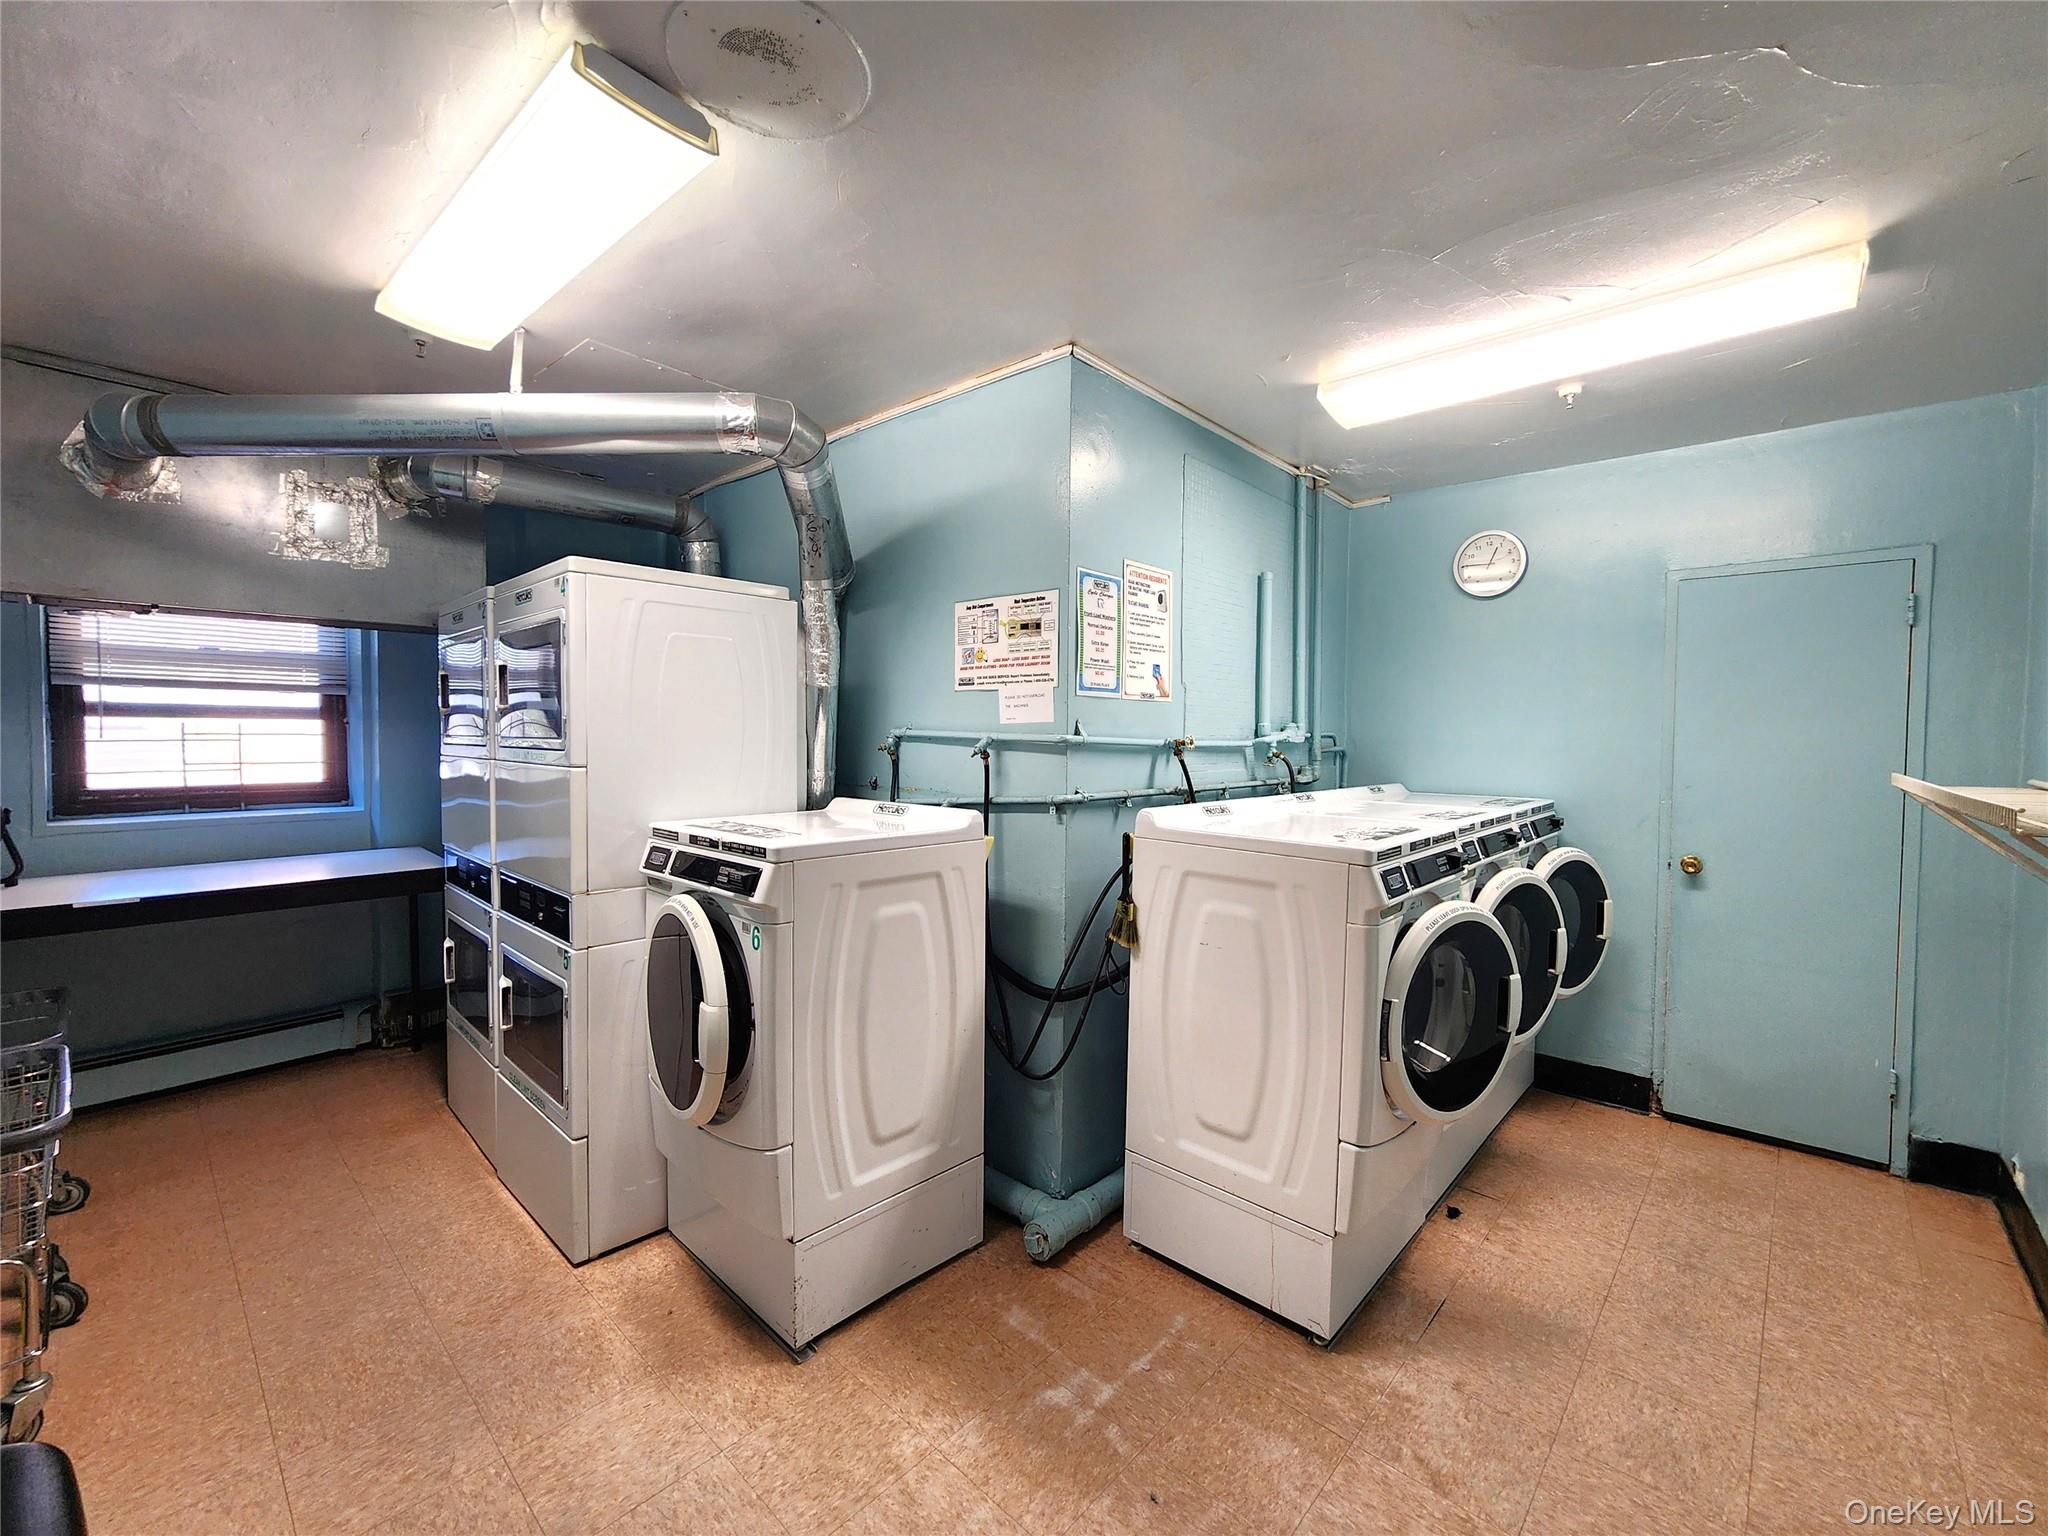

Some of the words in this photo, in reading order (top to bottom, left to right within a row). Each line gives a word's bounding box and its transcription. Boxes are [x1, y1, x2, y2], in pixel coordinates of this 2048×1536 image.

[1425, 917, 1439, 932] PLEASE
[752, 926, 760, 951] 6
[564, 950, 571, 970] 5
